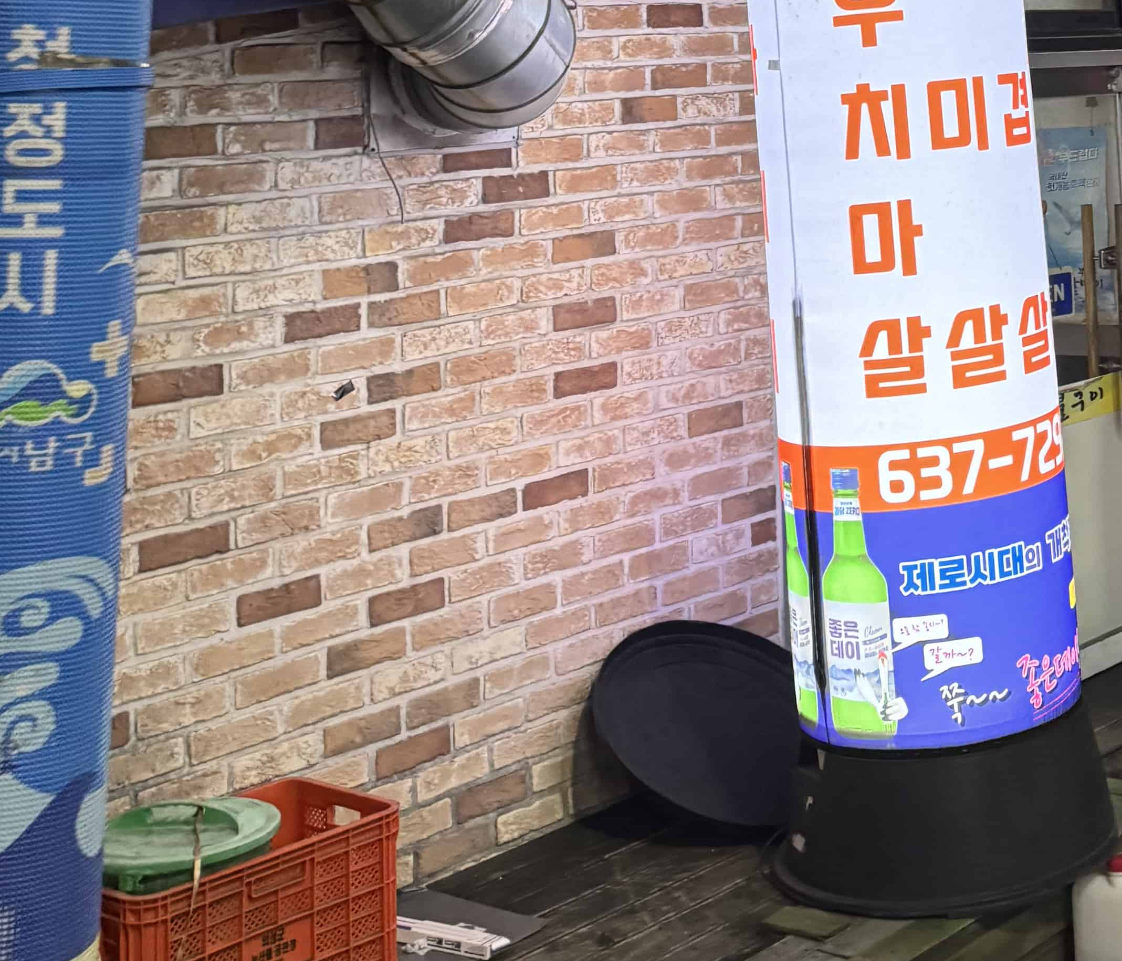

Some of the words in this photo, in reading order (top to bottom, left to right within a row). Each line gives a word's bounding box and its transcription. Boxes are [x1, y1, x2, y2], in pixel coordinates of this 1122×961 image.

[899, 541, 1043, 597] 제로시대의
[828, 618, 859, 640] 좋은
[830, 640, 861, 660] 데이
